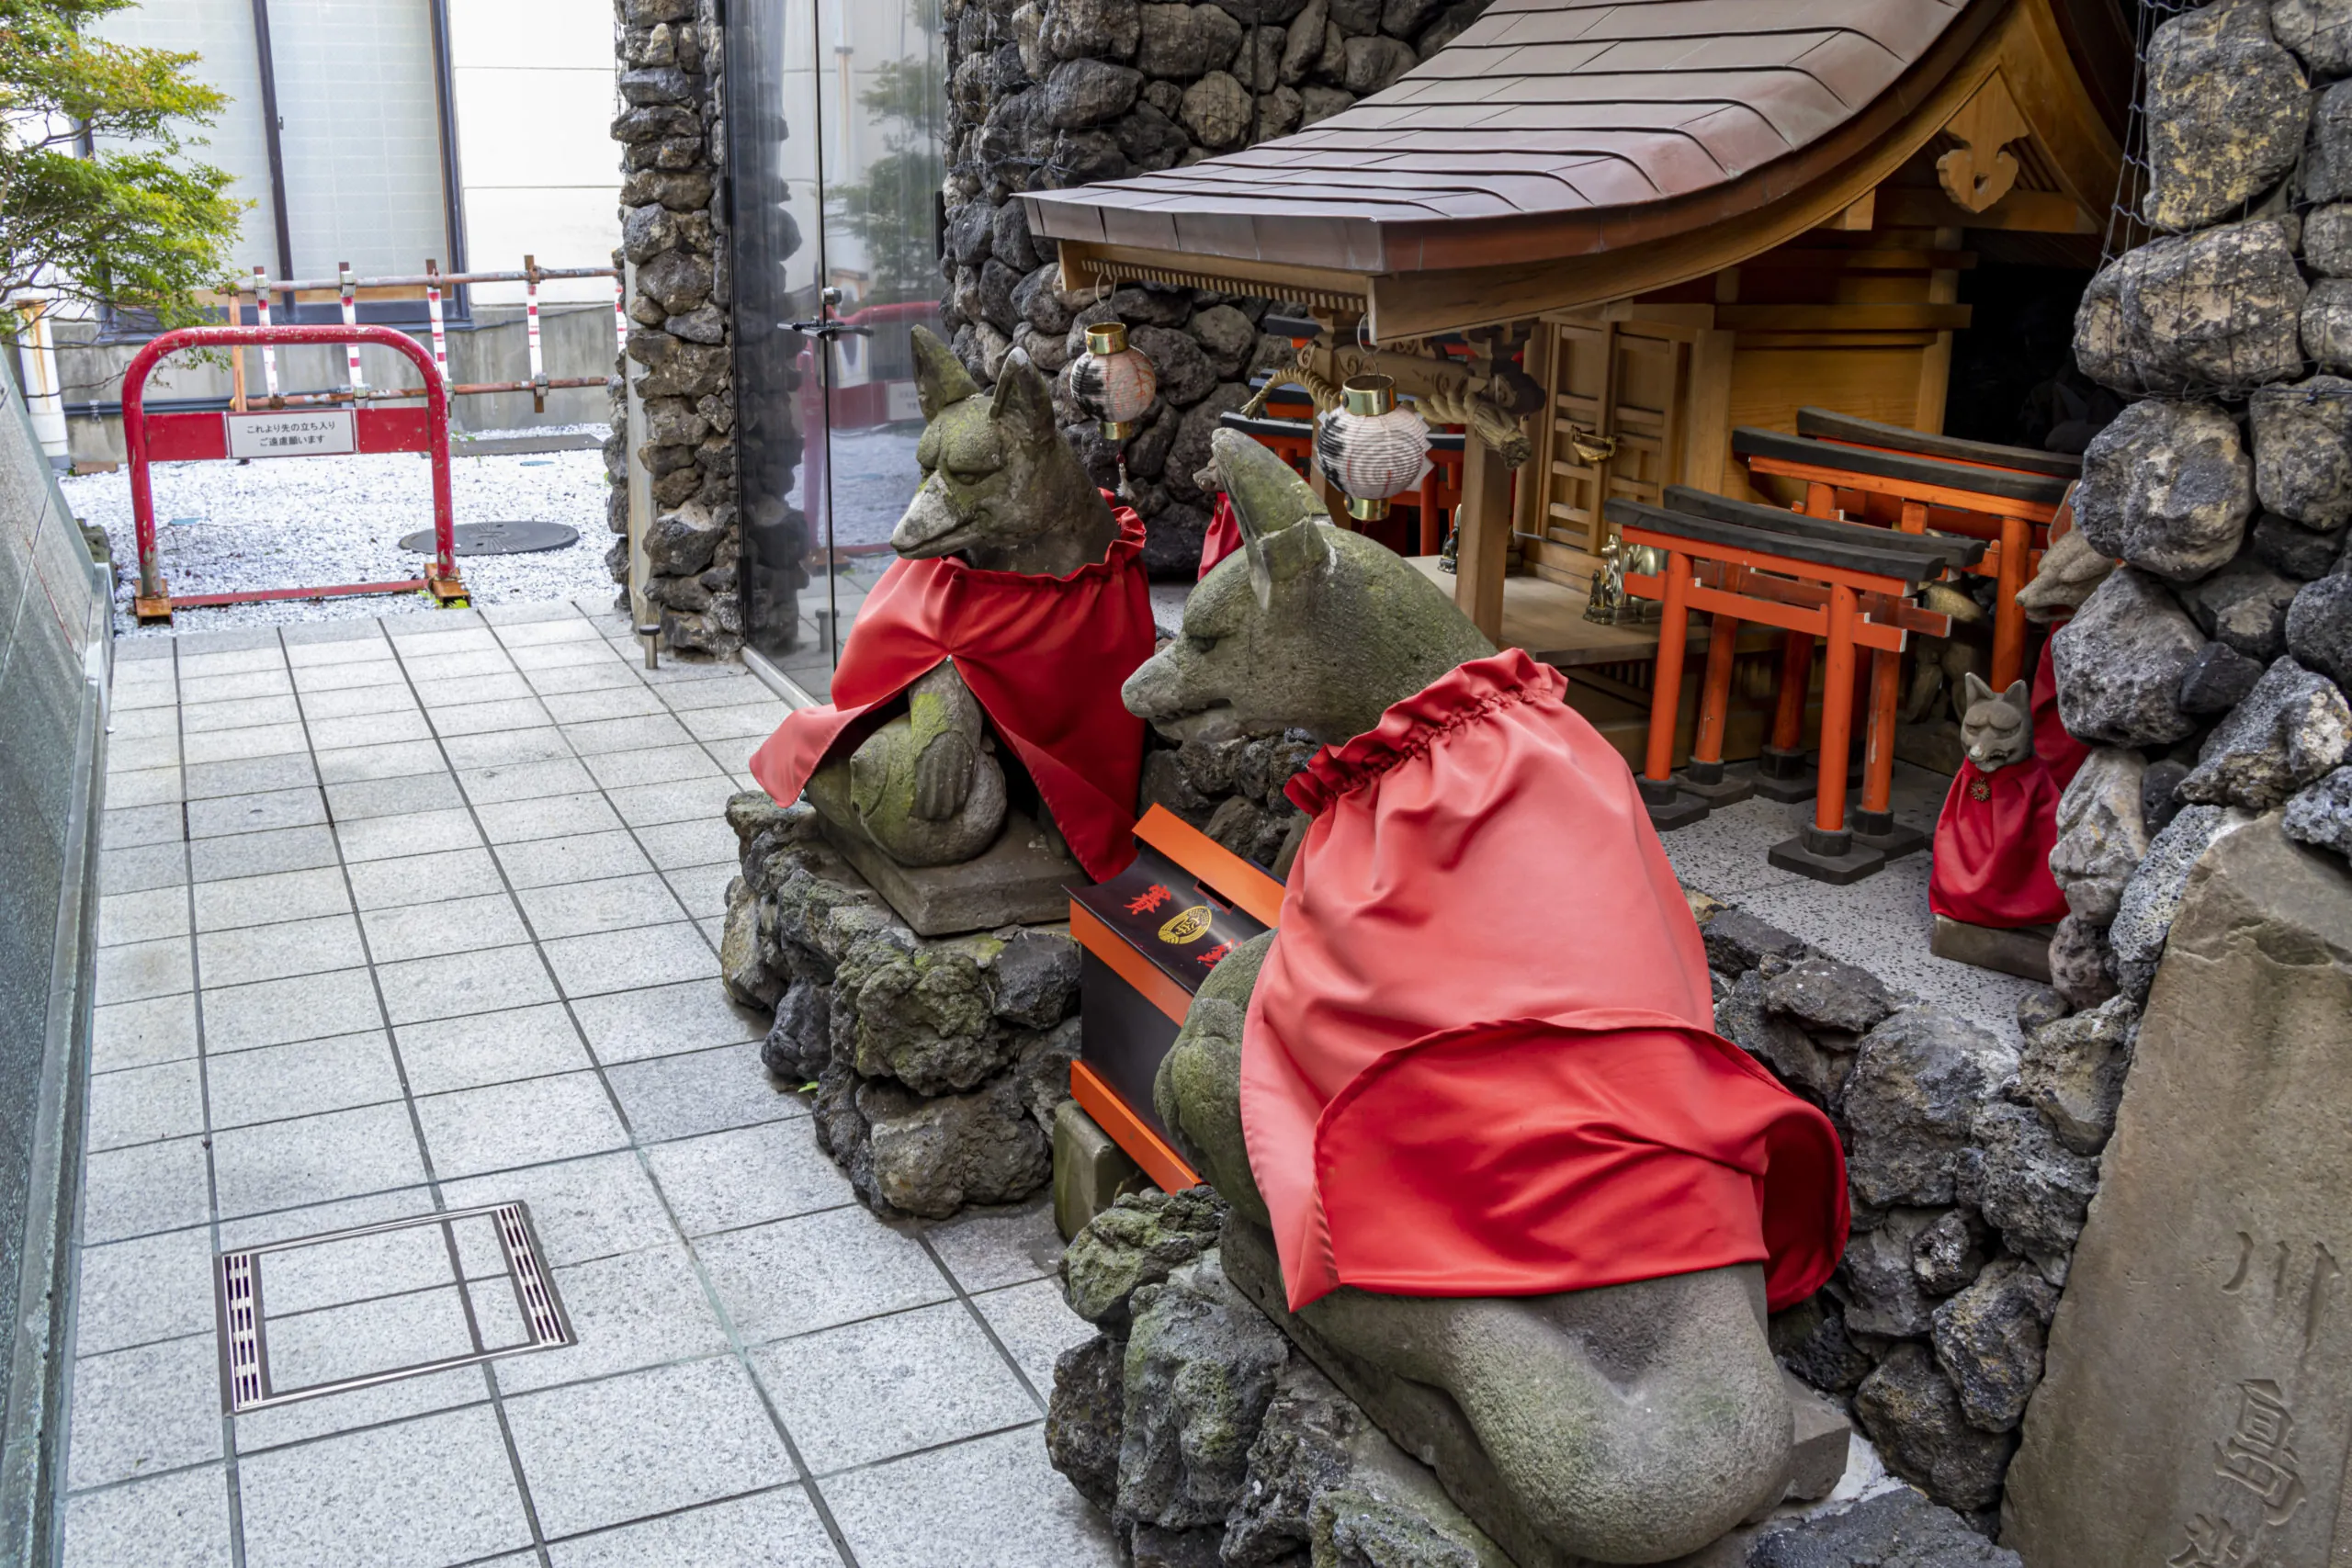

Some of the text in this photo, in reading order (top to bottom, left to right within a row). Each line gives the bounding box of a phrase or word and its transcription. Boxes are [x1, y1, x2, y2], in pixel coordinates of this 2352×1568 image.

[246, 421, 335, 434] これより先の立ち入り
[259, 434, 325, 447] ご遠慮願います
